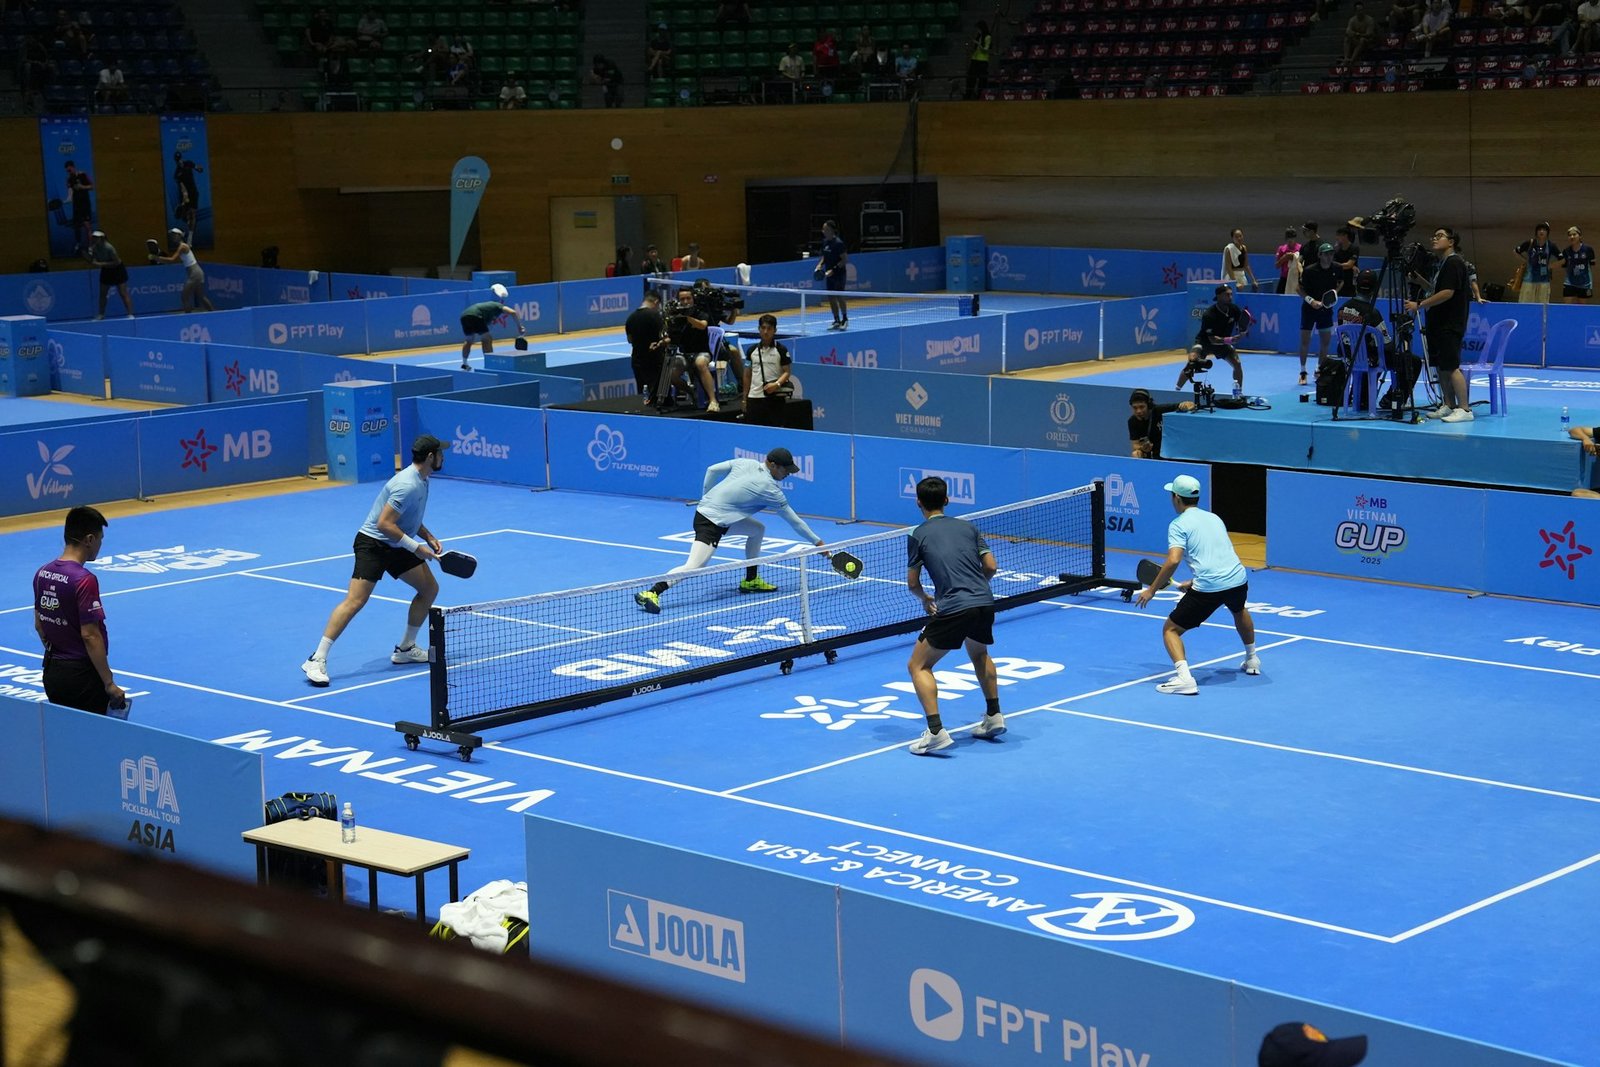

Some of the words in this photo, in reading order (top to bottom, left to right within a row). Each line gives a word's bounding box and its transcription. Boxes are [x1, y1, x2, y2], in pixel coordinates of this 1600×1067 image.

[456, 178, 482, 188] CUP
[1187, 268, 1215, 280] MB
[602, 295, 627, 309] JOOLA
[516, 302, 540, 320] MB
[180, 323, 212, 342] PPA
[290, 325, 314, 338] FPT
[318, 324, 344, 338] Play
[1042, 331, 1060, 344] FPT
[1063, 328, 1082, 343] Play
[18, 346, 43, 357] CUP
[848, 350, 878, 368] MB
[249, 368, 280, 394] MB
[330, 420, 351, 432] CUP
[361, 419, 388, 432] CUP
[896, 413, 912, 424] VIET
[914, 415, 942, 428] HUONG
[1046, 431, 1080, 443] ORIENT
[223, 430, 272, 462] MB
[612, 462, 660, 474] TUYENSON
[1369, 498, 1388, 508] MB
[1347, 508, 1396, 524] VIETNAM
[1104, 516, 1134, 533] SIA
[1335, 522, 1405, 552] CUP
[1360, 556, 1381, 565] 2025
[40, 596, 59, 608] CUP
[550, 642, 733, 681] MB
[882, 657, 1065, 700] MB
[638, 684, 662, 694] JOOLA
[428, 731, 451, 742] JOOLA
[210, 729, 556, 812] VIETNAM
[120, 756, 180, 814] PPA
[122, 801, 160, 820] PICKLEBALL
[162, 812, 180, 825] TOUR
[128, 820, 176, 853] ASIA
[746, 840, 837, 865] ASIA
[828, 840, 1020, 886] CONNECT
[830, 858, 865, 872] &
[864, 866, 1046, 912] AMERICA
[655, 910, 741, 972] JOOLA
[976, 996, 1050, 1054] FPT
[1063, 1026, 1150, 1067] Play
